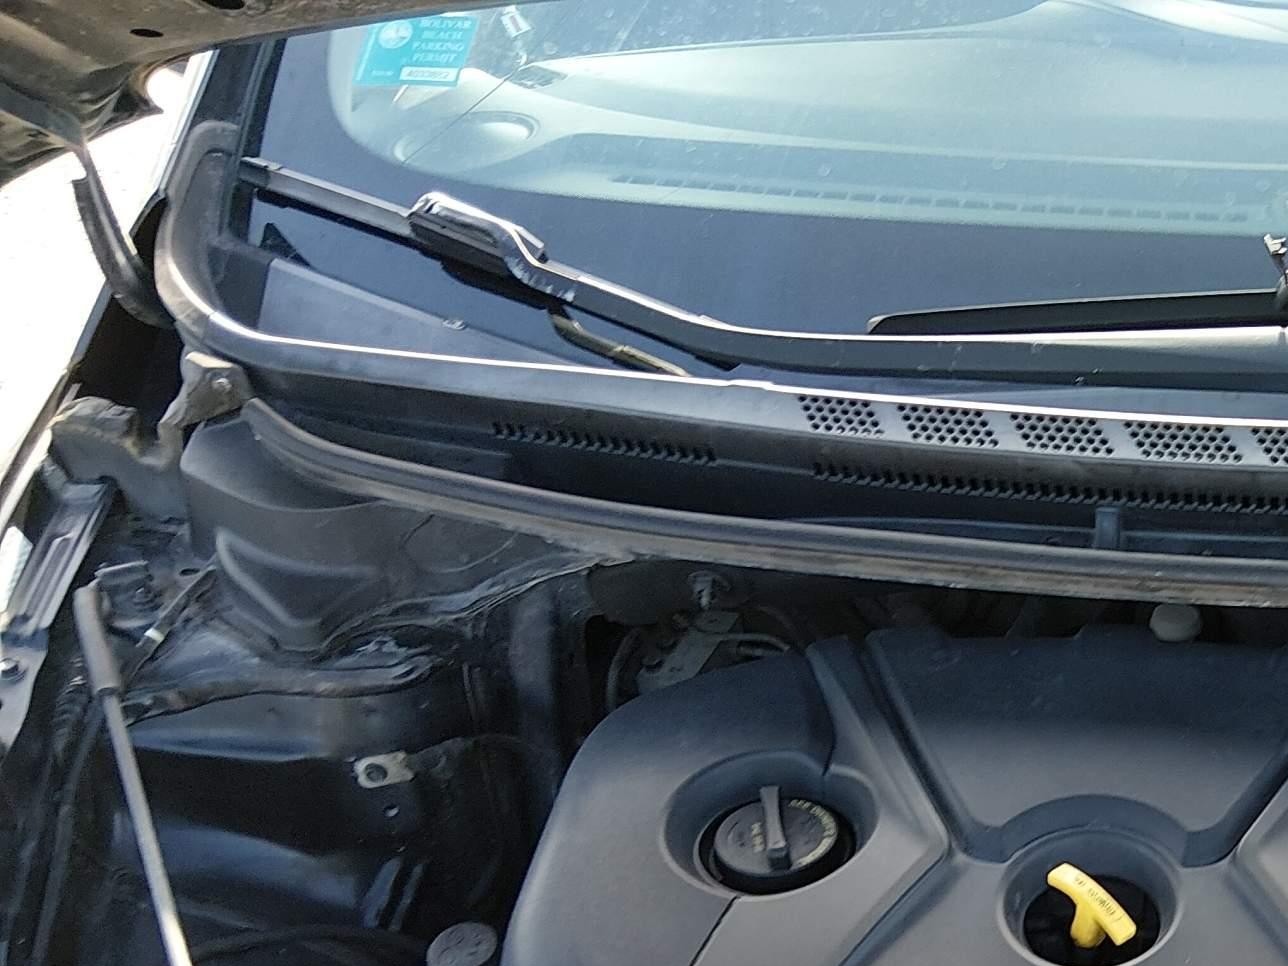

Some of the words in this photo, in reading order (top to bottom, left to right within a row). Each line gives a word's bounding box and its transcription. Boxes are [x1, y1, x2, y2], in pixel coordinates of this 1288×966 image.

[419, 19, 472, 29] BOLIVAR
[412, 41, 464, 52] PARKING
[412, 52, 457, 64] PERMIT
